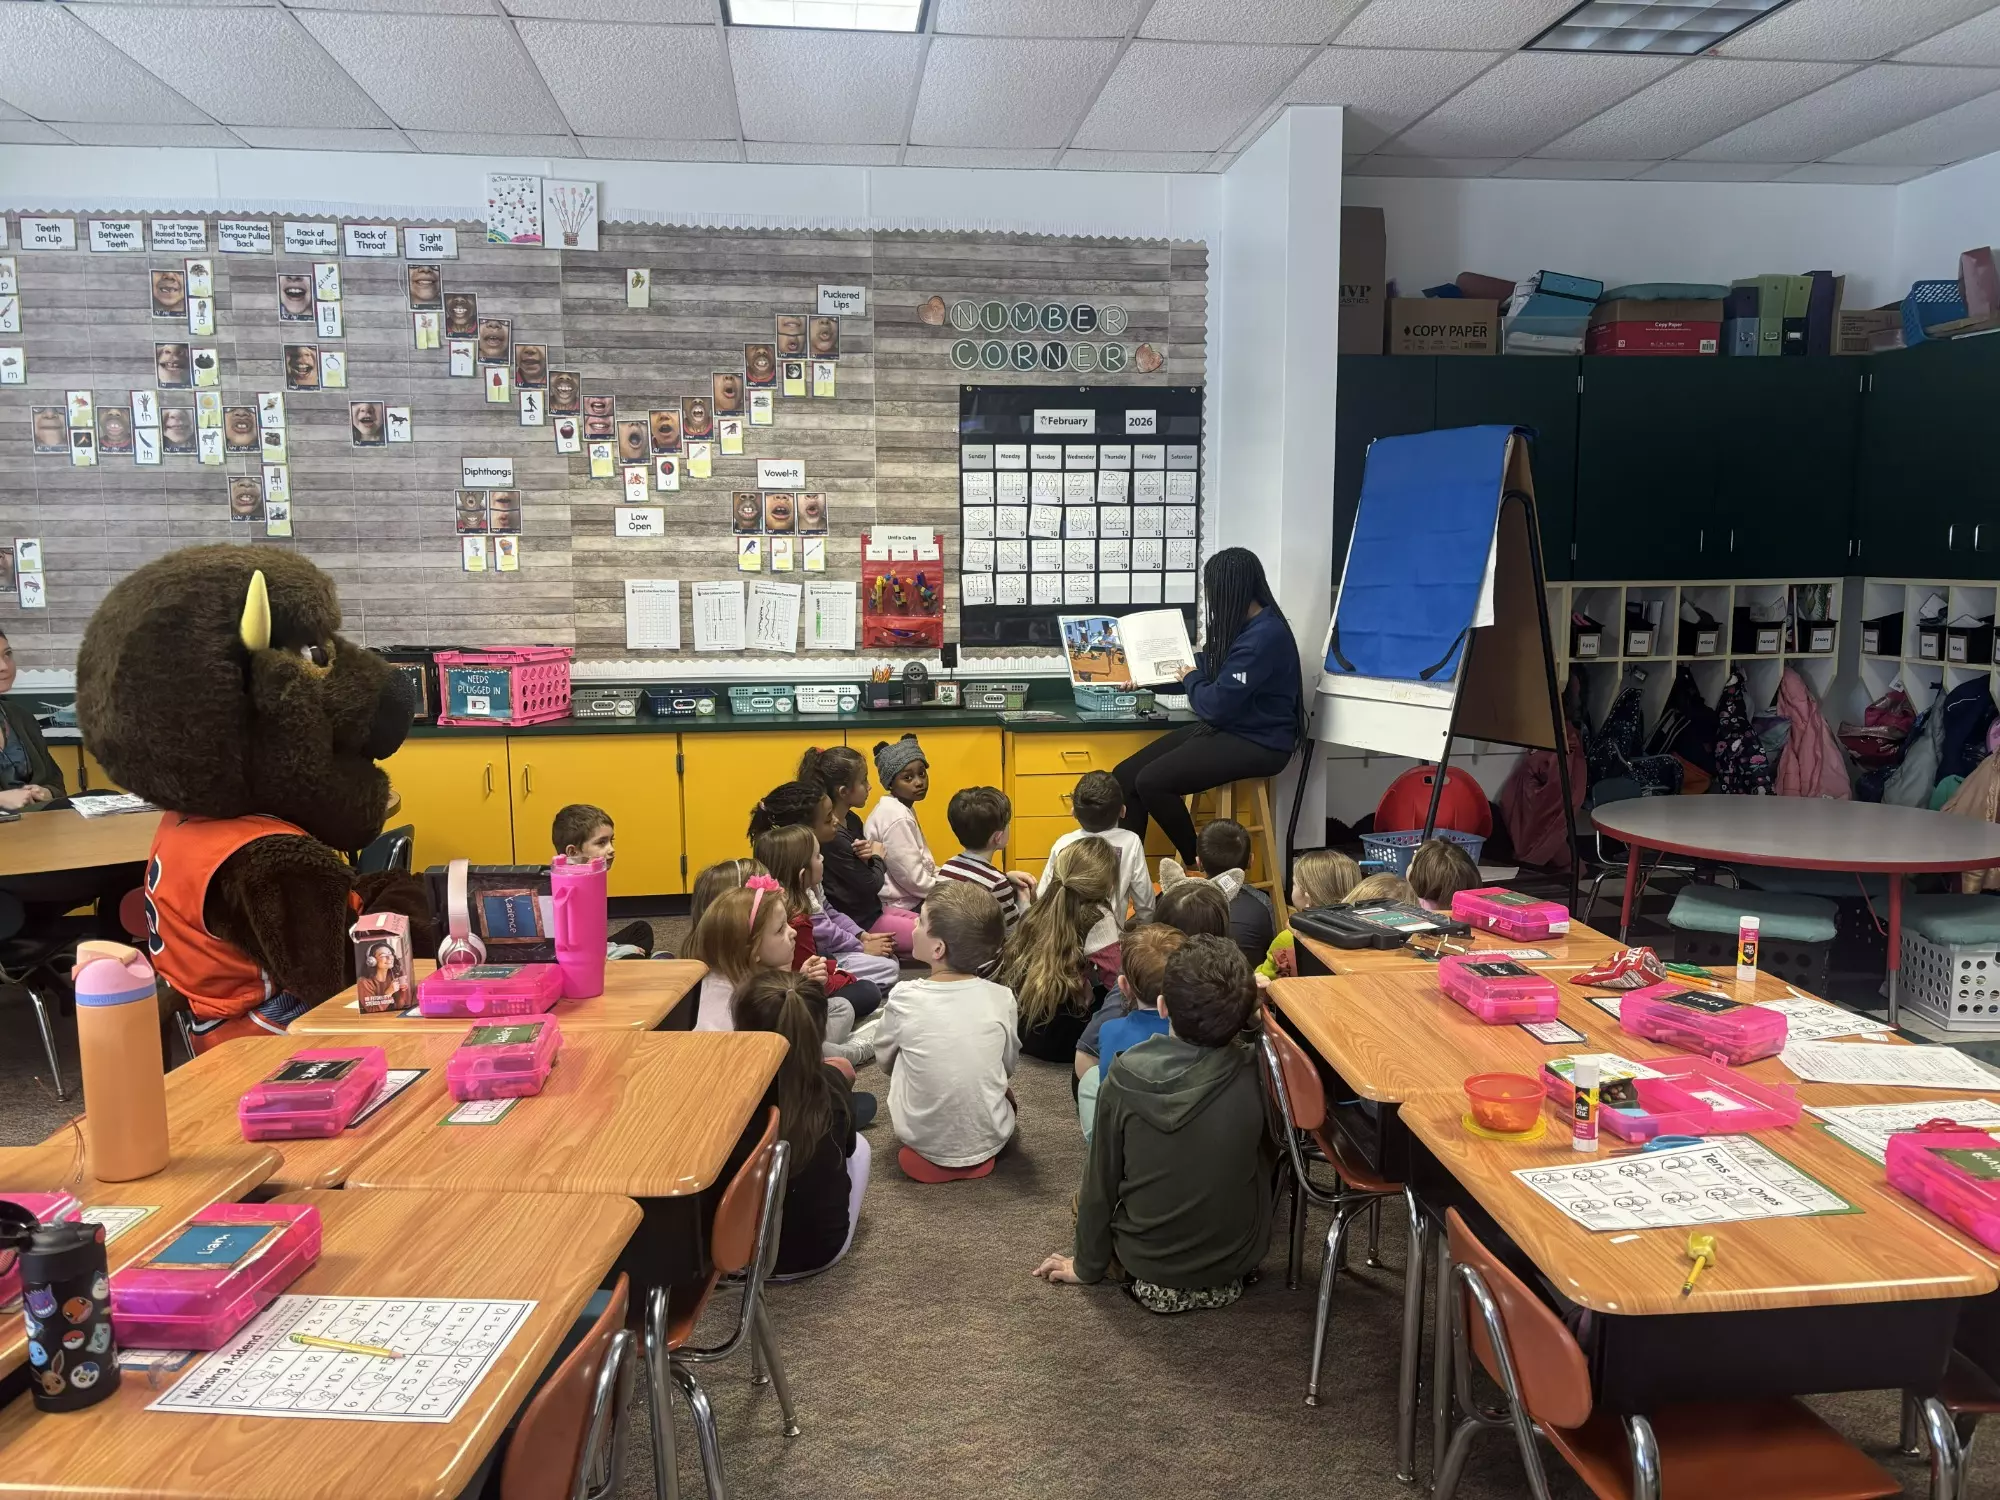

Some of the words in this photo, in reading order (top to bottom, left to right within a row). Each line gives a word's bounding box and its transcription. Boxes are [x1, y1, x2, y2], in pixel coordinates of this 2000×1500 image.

[35, 224, 60, 232] Teeth
[100, 222, 130, 231] Tongue
[220, 224, 234, 233] Lips
[48, 234, 62, 244] Lip
[220, 233, 246, 241] Tongue
[377, 231, 386, 239] of
[420, 234, 441, 243] Tight
[286, 238, 313, 247] Tongue
[357, 241, 385, 249] Throat
[823, 291, 859, 300] Puckered
[834, 301, 850, 310] Lips
[956, 305, 1121, 330] NUMBER
[1413, 325, 1446, 336] COPY
[1450, 326, 1487, 337] PAPER
[956, 344, 1121, 368] CORNER
[1048, 416, 1087, 427] February
[1129, 418, 1153, 426] 2026
[465, 468, 511, 477] Diphthongs
[764, 469, 798, 477] Vowel-R
[628, 522, 651, 531] Open
[468, 675, 489, 683] NEEDS
[458, 685, 490, 694] PLUGGED
[493, 686, 500, 695] IN
[1576, 1103, 1588, 1111] Glue
[1702, 1153, 1730, 1173] Tens
[1748, 1187, 1782, 1206] Ones
[197, 1234, 230, 1255] Liam
[186, 1368, 231, 1399] Missing
[224, 1334, 264, 1365] Addend
